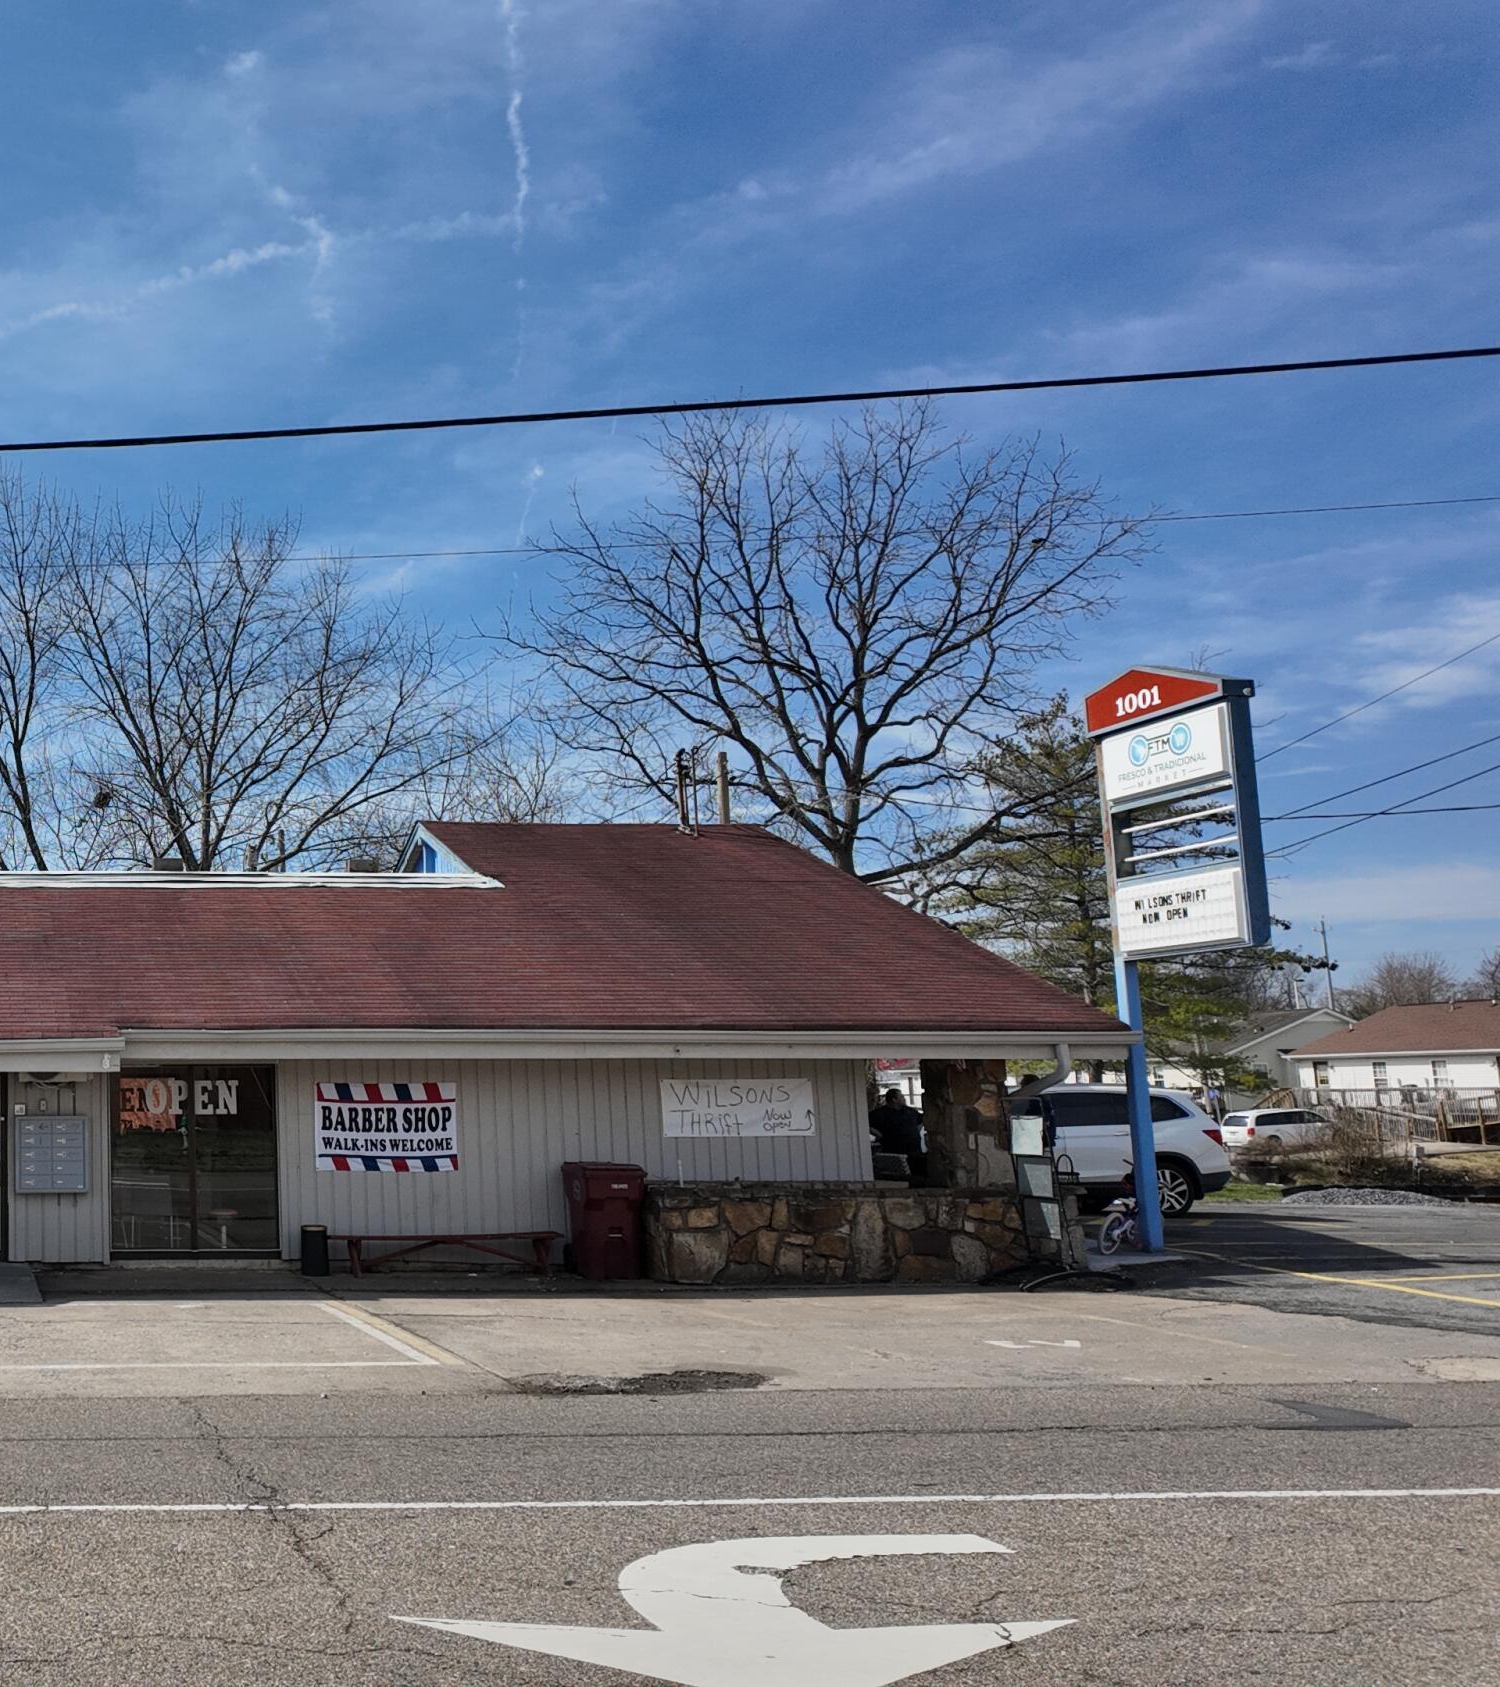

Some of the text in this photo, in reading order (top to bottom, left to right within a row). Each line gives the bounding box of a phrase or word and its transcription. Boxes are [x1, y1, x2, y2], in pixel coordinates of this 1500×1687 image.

[1116, 685, 1161, 717] 1001
[1148, 737, 1170, 752] FTM
[1118, 752, 1207, 782] FRESCO & TRADICIONAL
[1137, 769, 1186, 787] MARKET
[1175, 889, 1206, 903] THRIFT
[1142, 907, 1188, 924] NOW OPEN
[146, 1079, 239, 1115] OPEN
[321, 1106, 452, 1132] BARBER SHOP
[322, 1137, 453, 1152] WALK-INS WELCOME
